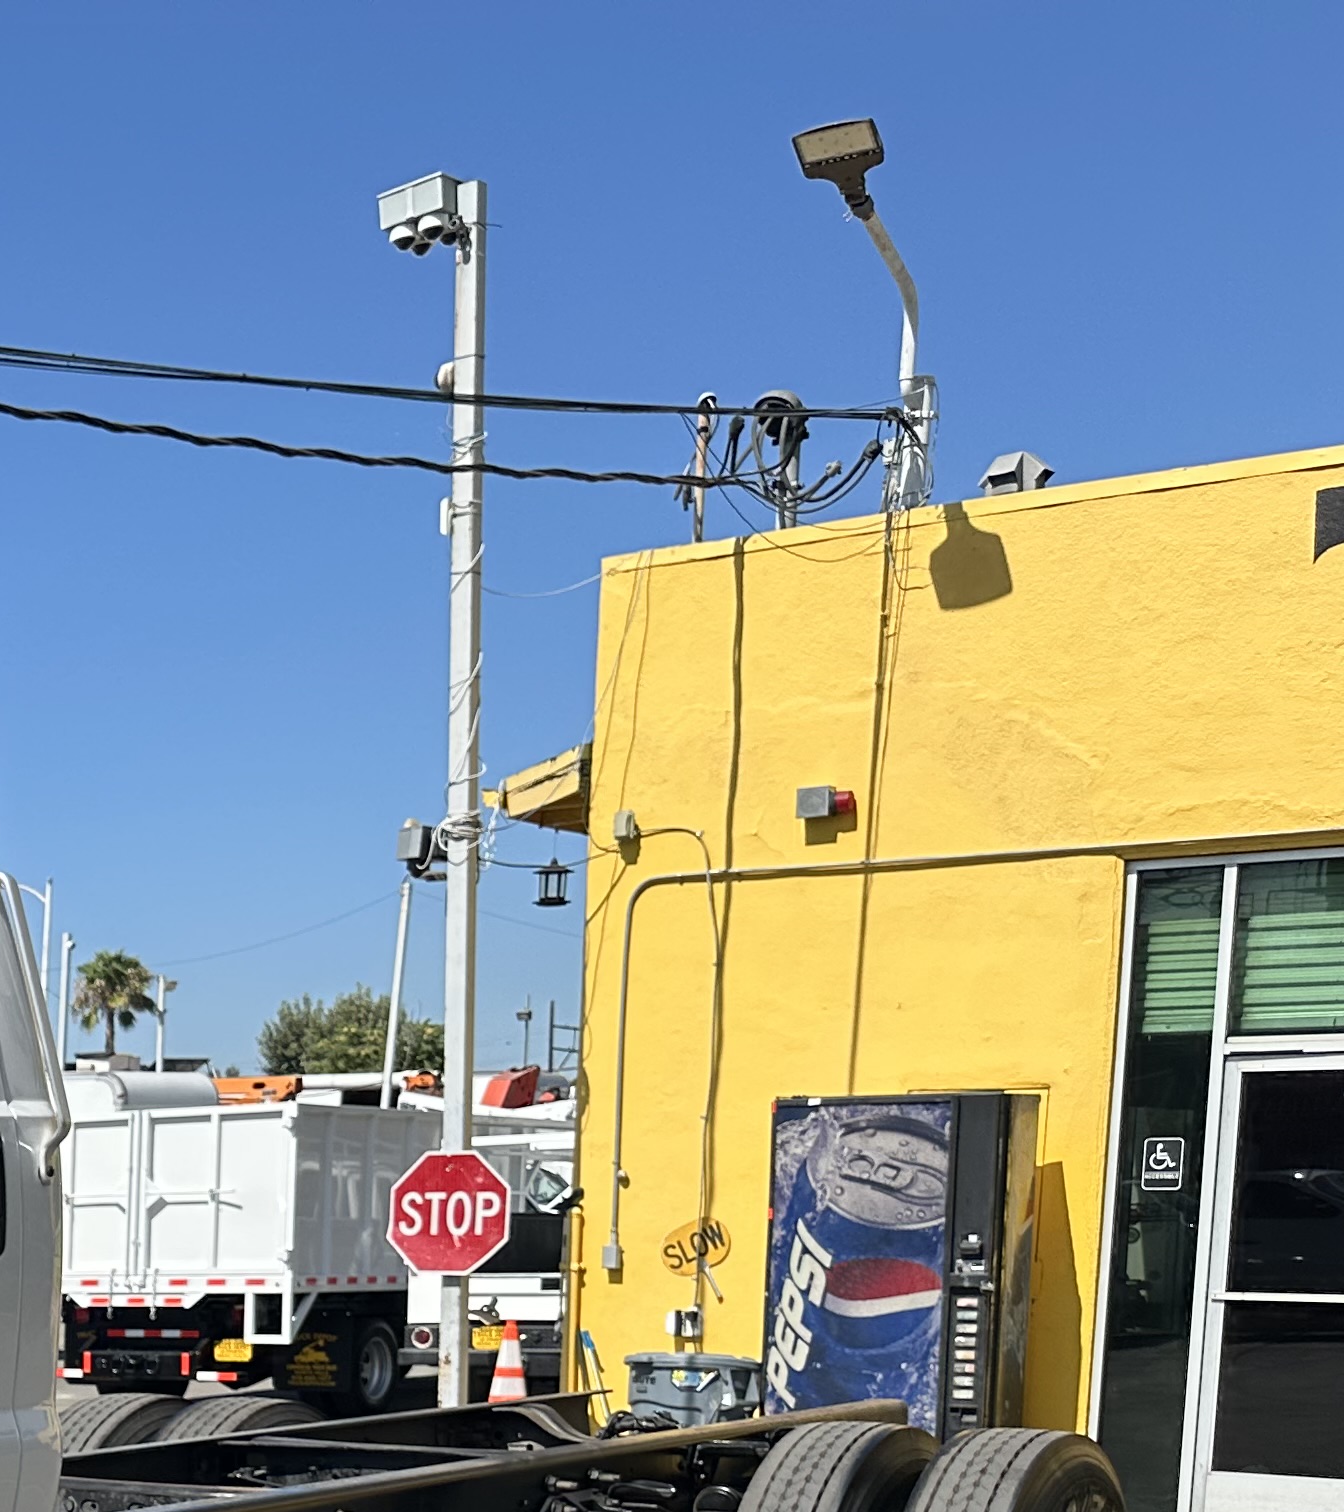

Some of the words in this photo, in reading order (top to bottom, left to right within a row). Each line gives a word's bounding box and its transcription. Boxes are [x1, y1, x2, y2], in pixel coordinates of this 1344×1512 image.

[398, 1190, 502, 1237] STOP
[663, 1220, 726, 1269] SLOW
[766, 1217, 833, 1409] PEPSI
